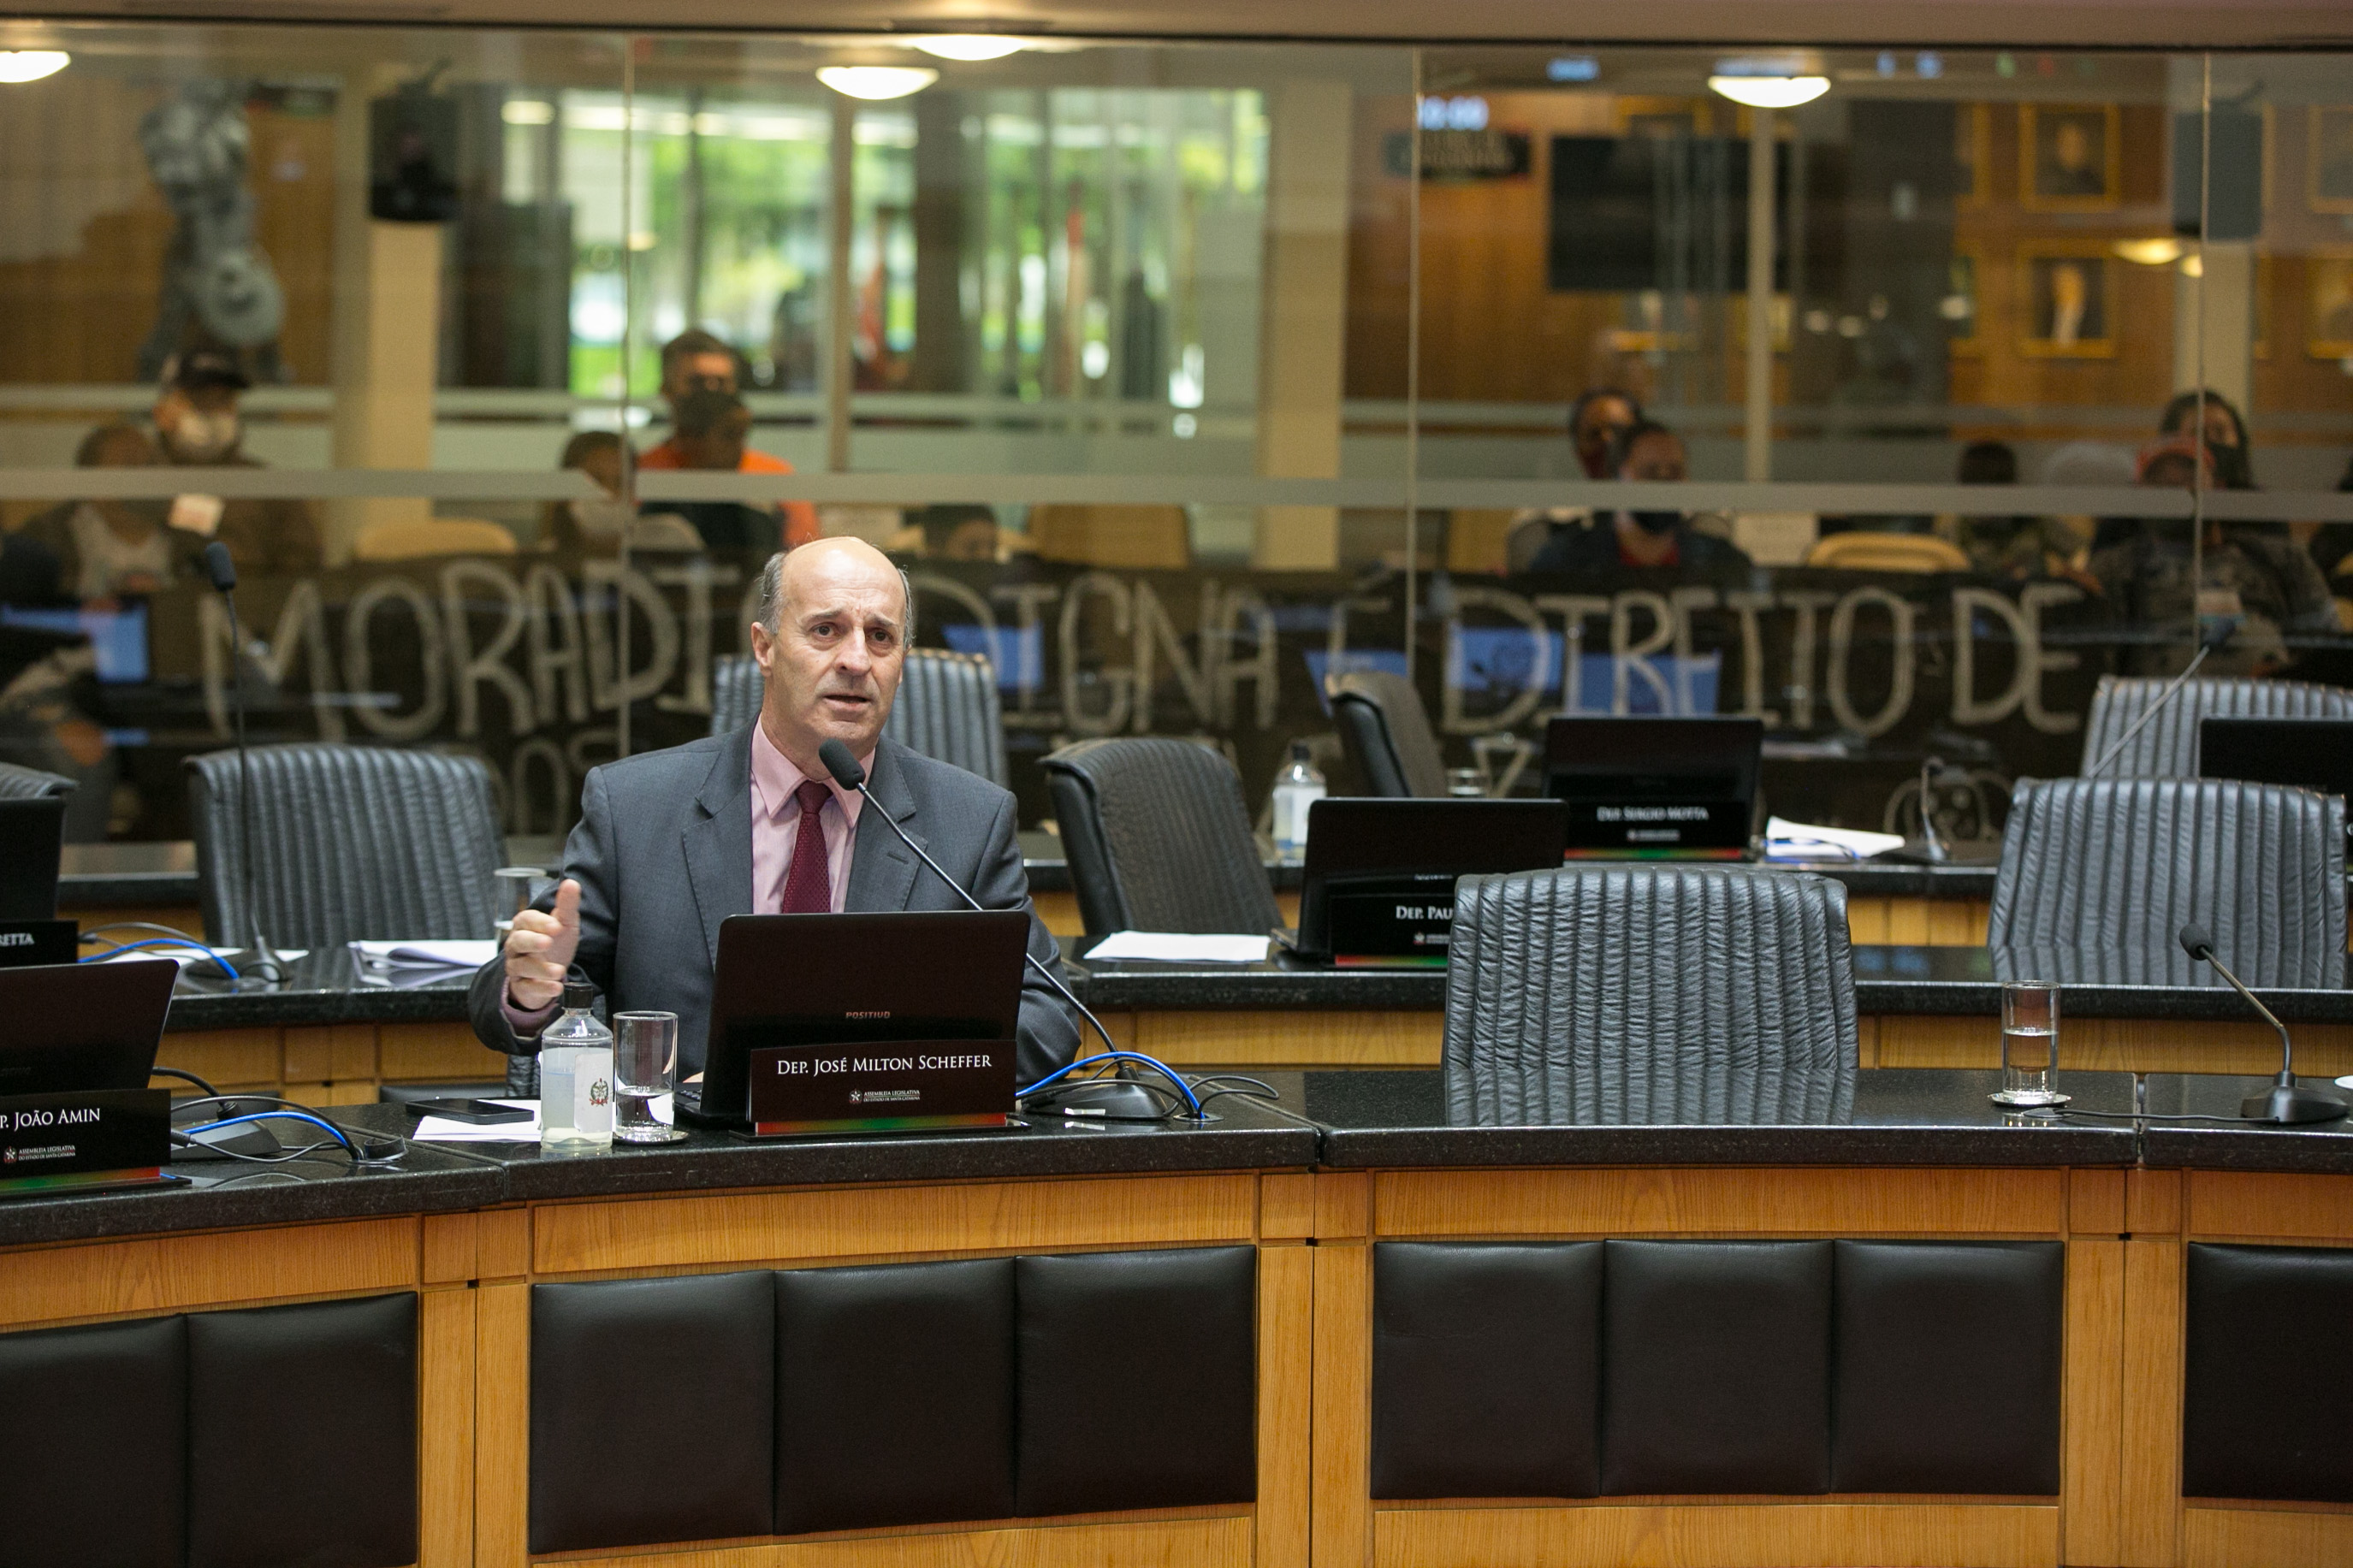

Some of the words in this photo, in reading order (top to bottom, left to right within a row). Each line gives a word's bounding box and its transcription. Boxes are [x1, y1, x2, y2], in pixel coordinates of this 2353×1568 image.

[199, 558, 762, 743] MORADI
[1951, 582, 2084, 734] DE
[777, 1060, 809, 1074] DEP.
[814, 1056, 847, 1077] JOSÉ
[853, 1057, 913, 1073] MILTON
[918, 1055, 992, 1070] SCHEFFER
[14, 1109, 53, 1132] JOÃO
[57, 1108, 100, 1125] AMIN
